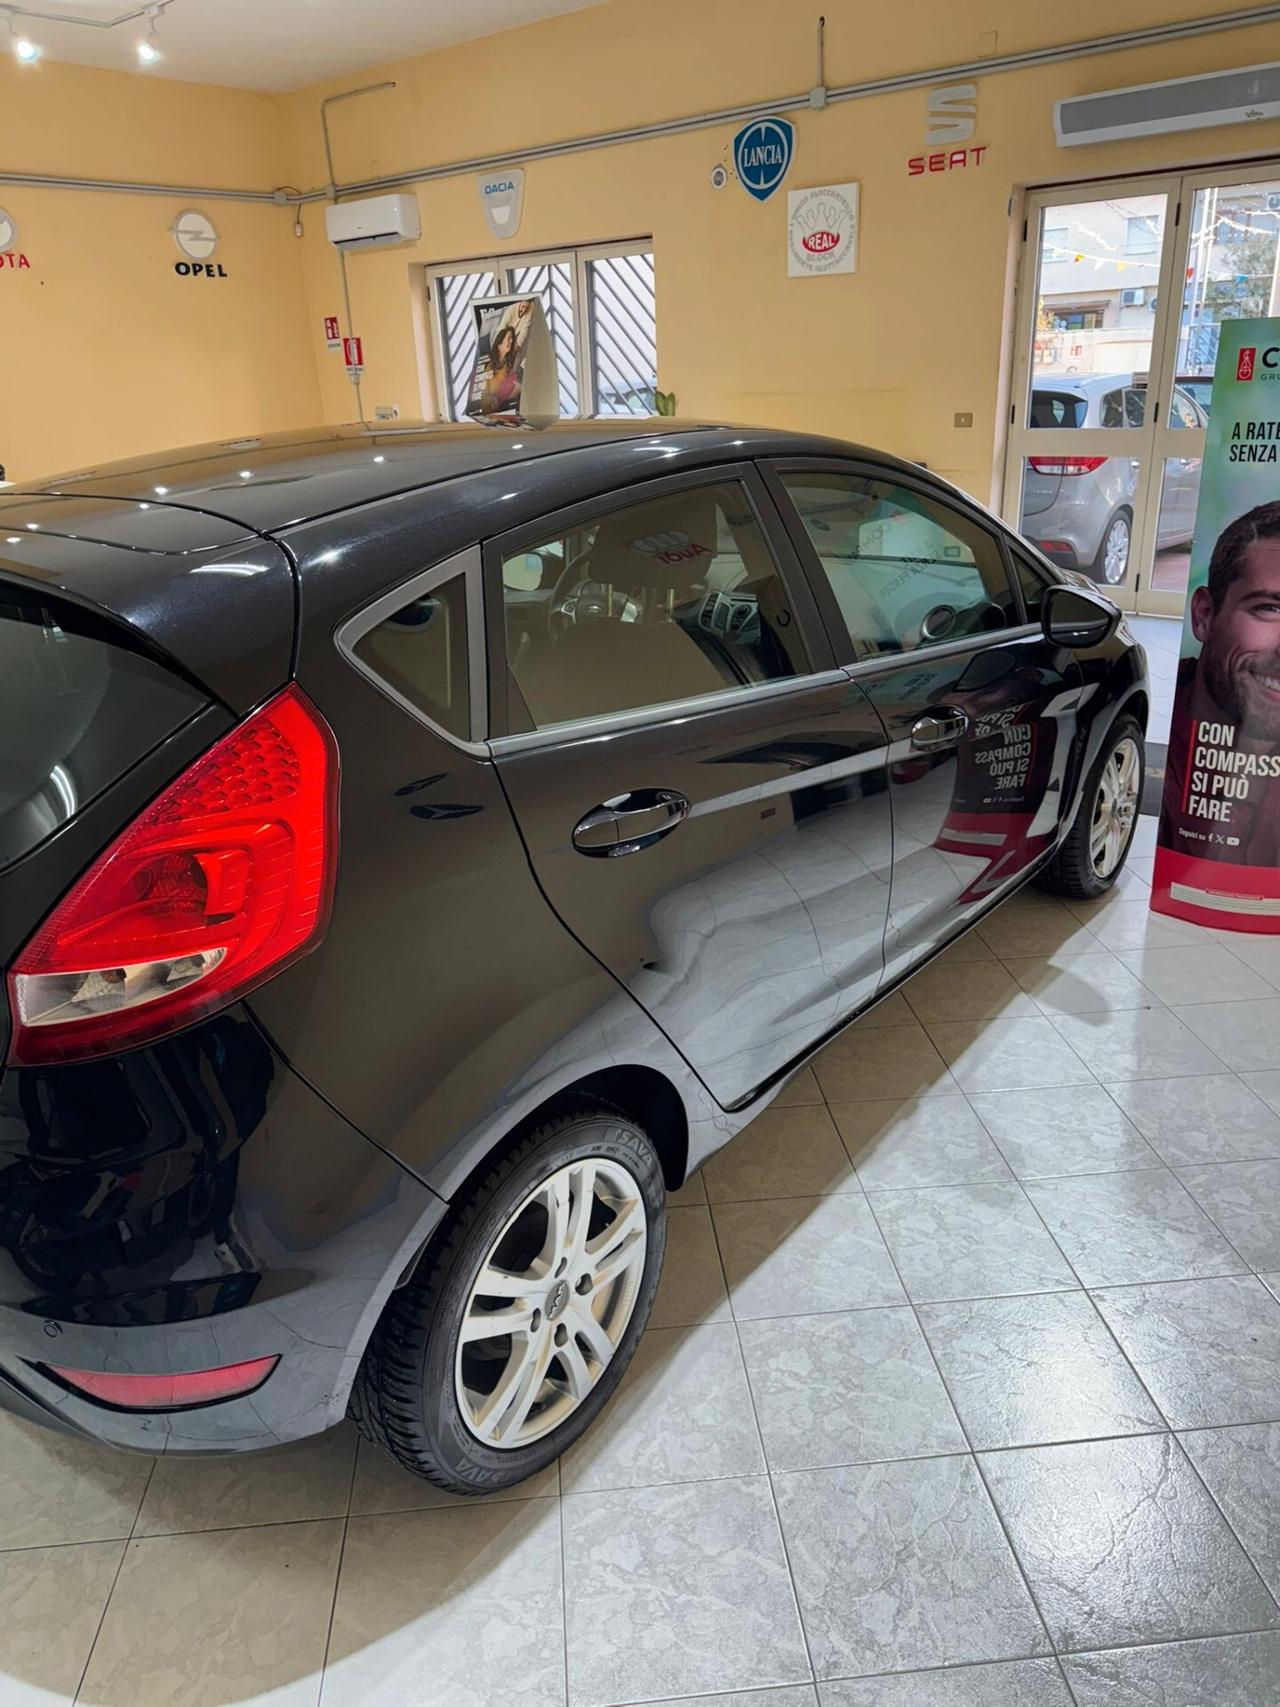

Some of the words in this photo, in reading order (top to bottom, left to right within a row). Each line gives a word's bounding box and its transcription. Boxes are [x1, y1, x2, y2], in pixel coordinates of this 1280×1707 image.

[743, 144, 782, 167] LANCIA
[908, 146, 987, 176] SEAT
[484, 181, 514, 195] DACIA
[807, 232, 835, 250] REAL
[175, 262, 228, 277] OPEL
[1232, 422, 1240, 440] A
[1229, 444, 1277, 462] SENZA
[1198, 721, 1235, 747] CON
[1194, 746, 1280, 778] COMPASS
[1191, 771, 1209, 793] SI
[1212, 774, 1249, 800] PUÒ
